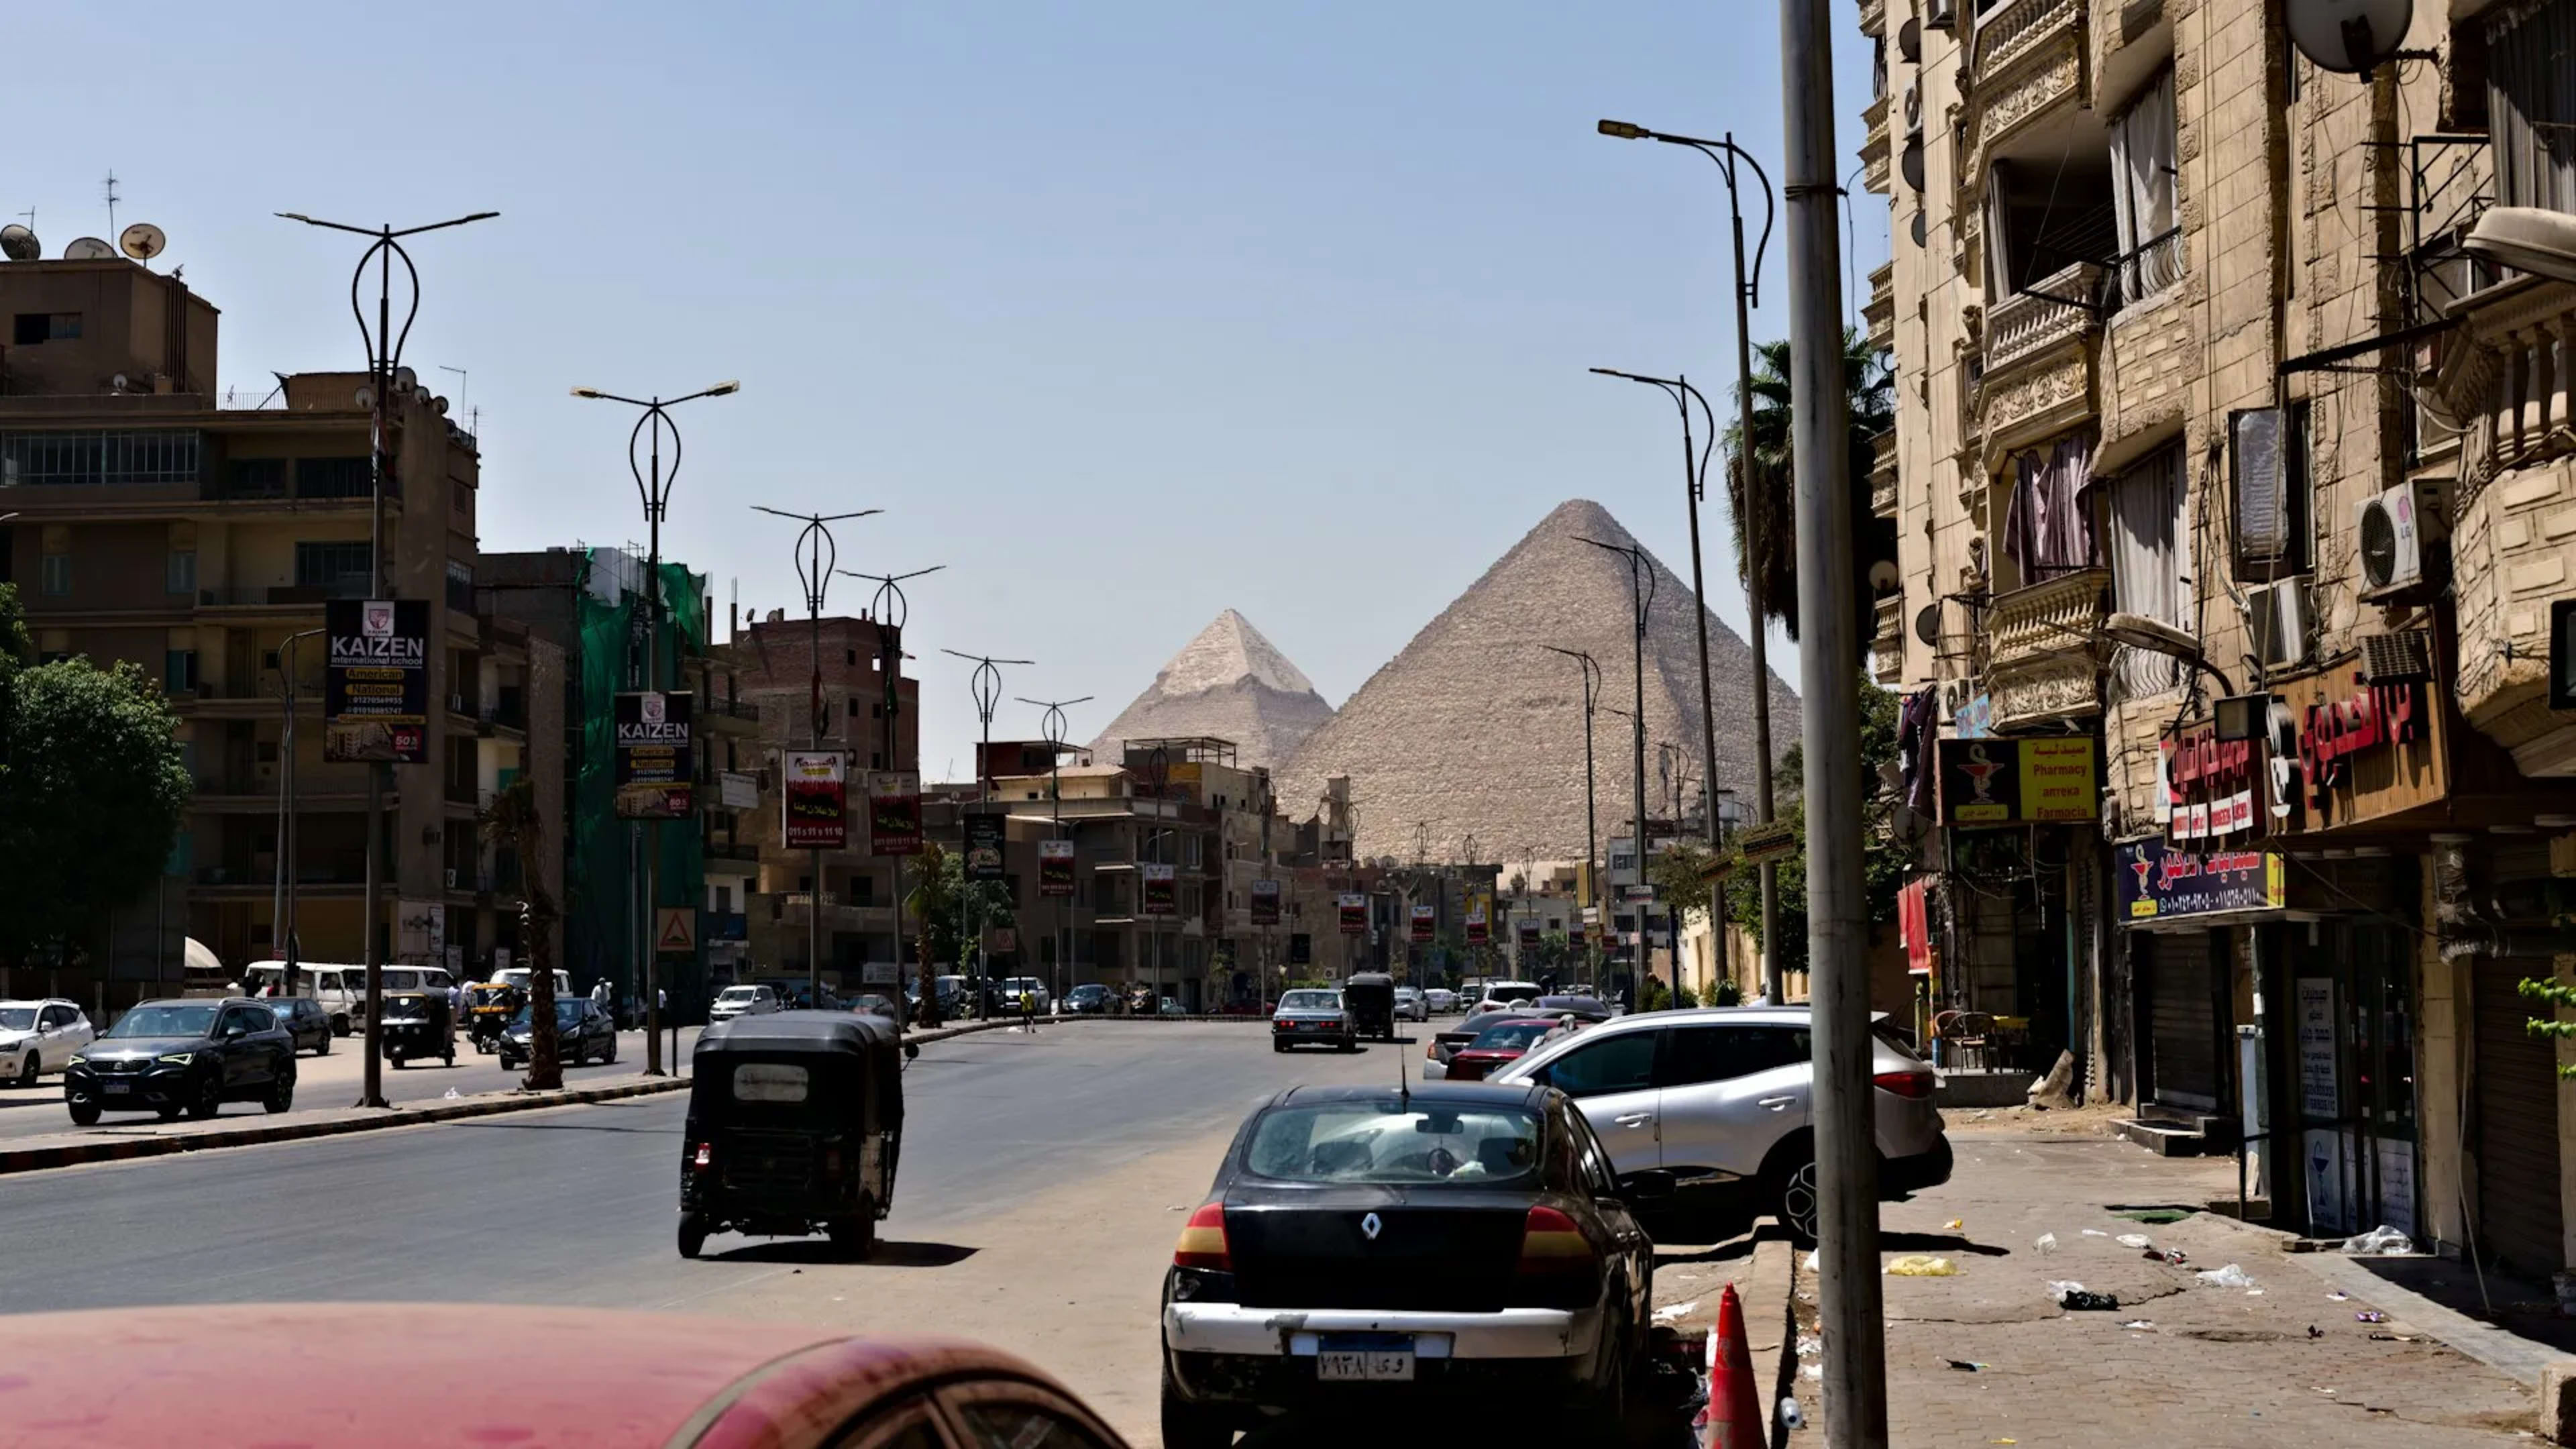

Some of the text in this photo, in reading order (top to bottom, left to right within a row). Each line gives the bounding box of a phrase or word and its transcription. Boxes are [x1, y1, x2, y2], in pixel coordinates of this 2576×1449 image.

[2400, 525, 2411, 539] LG
[332, 636, 424, 657] KAIZEN
[331, 657, 423, 665] international school
[349, 669, 402, 678] American
[353, 686, 400, 694] National
[618, 723, 689, 739] KAIZEN
[2033, 763, 2087, 777] Pharmacy
[2042, 786, 2080, 798] аптека
[2037, 806, 2088, 818] Farmacia
